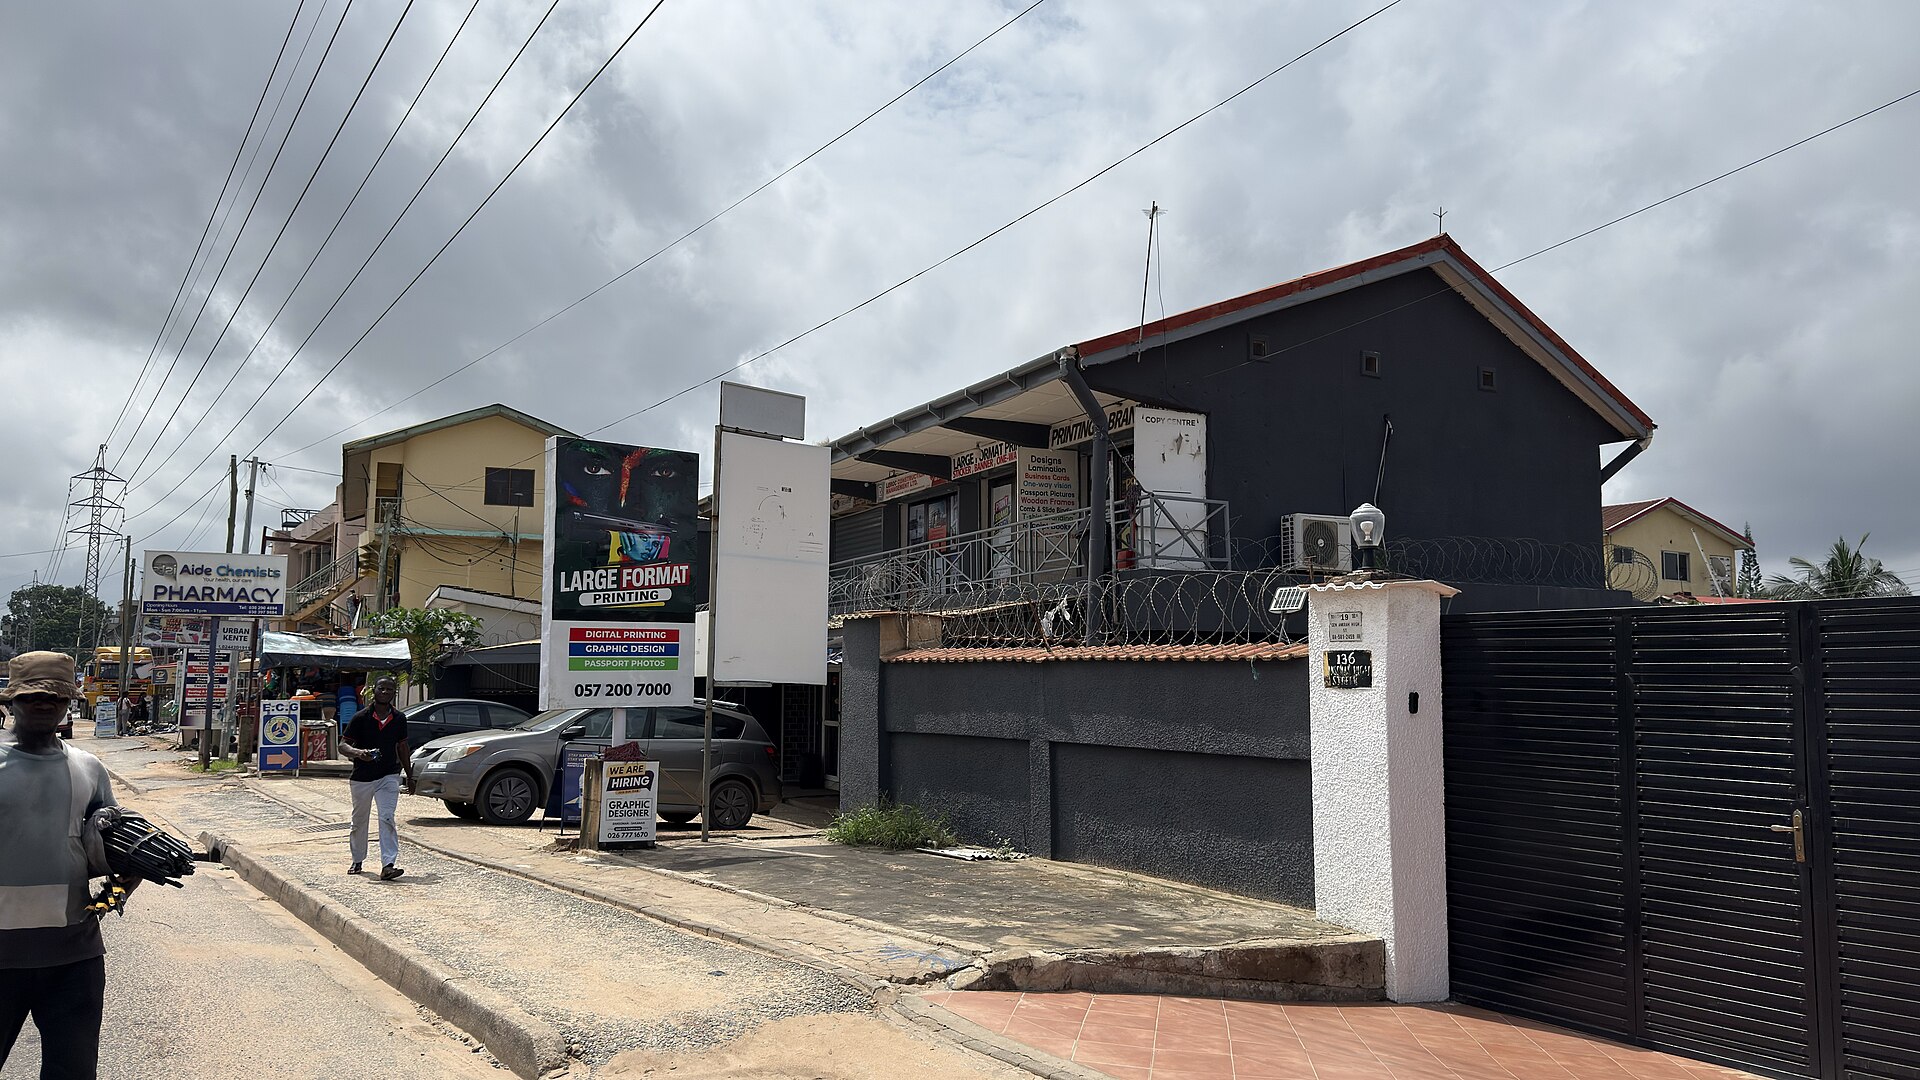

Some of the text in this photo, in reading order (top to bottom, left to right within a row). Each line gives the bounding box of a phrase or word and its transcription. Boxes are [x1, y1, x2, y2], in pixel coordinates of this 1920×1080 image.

[953, 452, 975, 470] LARGE
[975, 443, 1004, 464] ORMAT
[1030, 455, 1062, 465] Designs
[974, 458, 994, 472] BANNER
[1027, 464, 1067, 473] Lamination
[1024, 473, 1070, 482] Business Cards
[1023, 480, 1053, 489] One-way
[1020, 489, 1075, 498] Passport Pictures
[1021, 497, 1075, 506] Wooden Frames
[1019, 505, 1036, 513] Comb
[179, 564, 281, 578] Aide Chemists
[560, 565, 689, 593] LARGE FORMAT
[153, 584, 280, 603] PHARMACY
[593, 590, 659, 604] PRINTING
[222, 634, 249, 642] KENTE
[585, 630, 667, 639] DIGITAL PRINTING
[585, 644, 665, 653] GRAPHIC DESIGN
[1336, 651, 1356, 665] 136
[584, 660, 628, 668] PASSPORT
[574, 682, 672, 697] 057 200 7000
[609, 765, 644, 775] WE ARE
[611, 775, 650, 789] HIRING
[609, 800, 650, 809] GRAPHIC
[608, 809, 649, 818] DESIGNER
